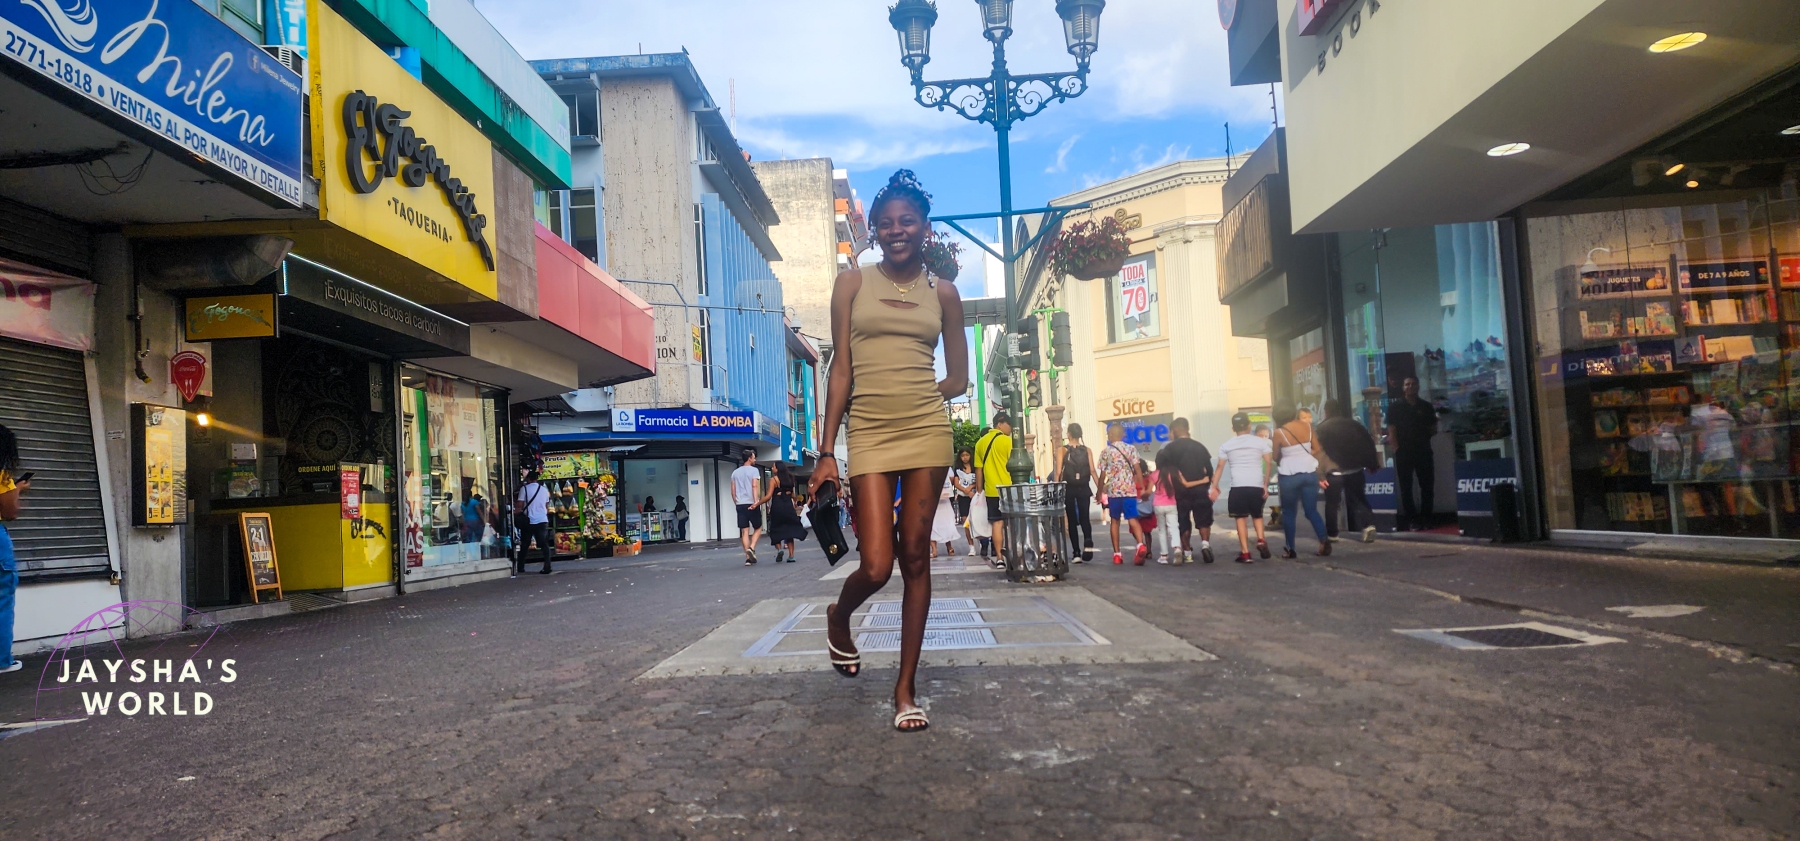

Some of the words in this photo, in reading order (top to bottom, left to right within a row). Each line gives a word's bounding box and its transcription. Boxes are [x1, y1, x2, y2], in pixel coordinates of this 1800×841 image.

[100, 0, 275, 147] Milena
[279, 74, 300, 95] Jewelry
[5, 30, 92, 94] 2771-1818
[110, 86, 162, 131] VENTAS
[165, 118, 181, 141] AL
[184, 127, 207, 155] POR
[211, 141, 248, 174] MAYOR
[250, 159, 259, 181] Y
[261, 164, 300, 202] DETALLE
[391, 196, 450, 244] TAQUERIA
[1121, 263, 1145, 281] TODA
[1728, 269, 1751, 278] AÑOS
[324, 279, 378, 314] ¡Exquisitos
[379, 300, 404, 323] tacos
[404, 310, 412, 326] al
[412, 315, 441, 337] carbón!
[1122, 285, 1147, 316] 70
[638, 414, 689, 427] Farmacia
[693, 415, 710, 427] LA
[711, 415, 753, 428] BOMBA
[1112, 399, 1155, 417] Sucre
